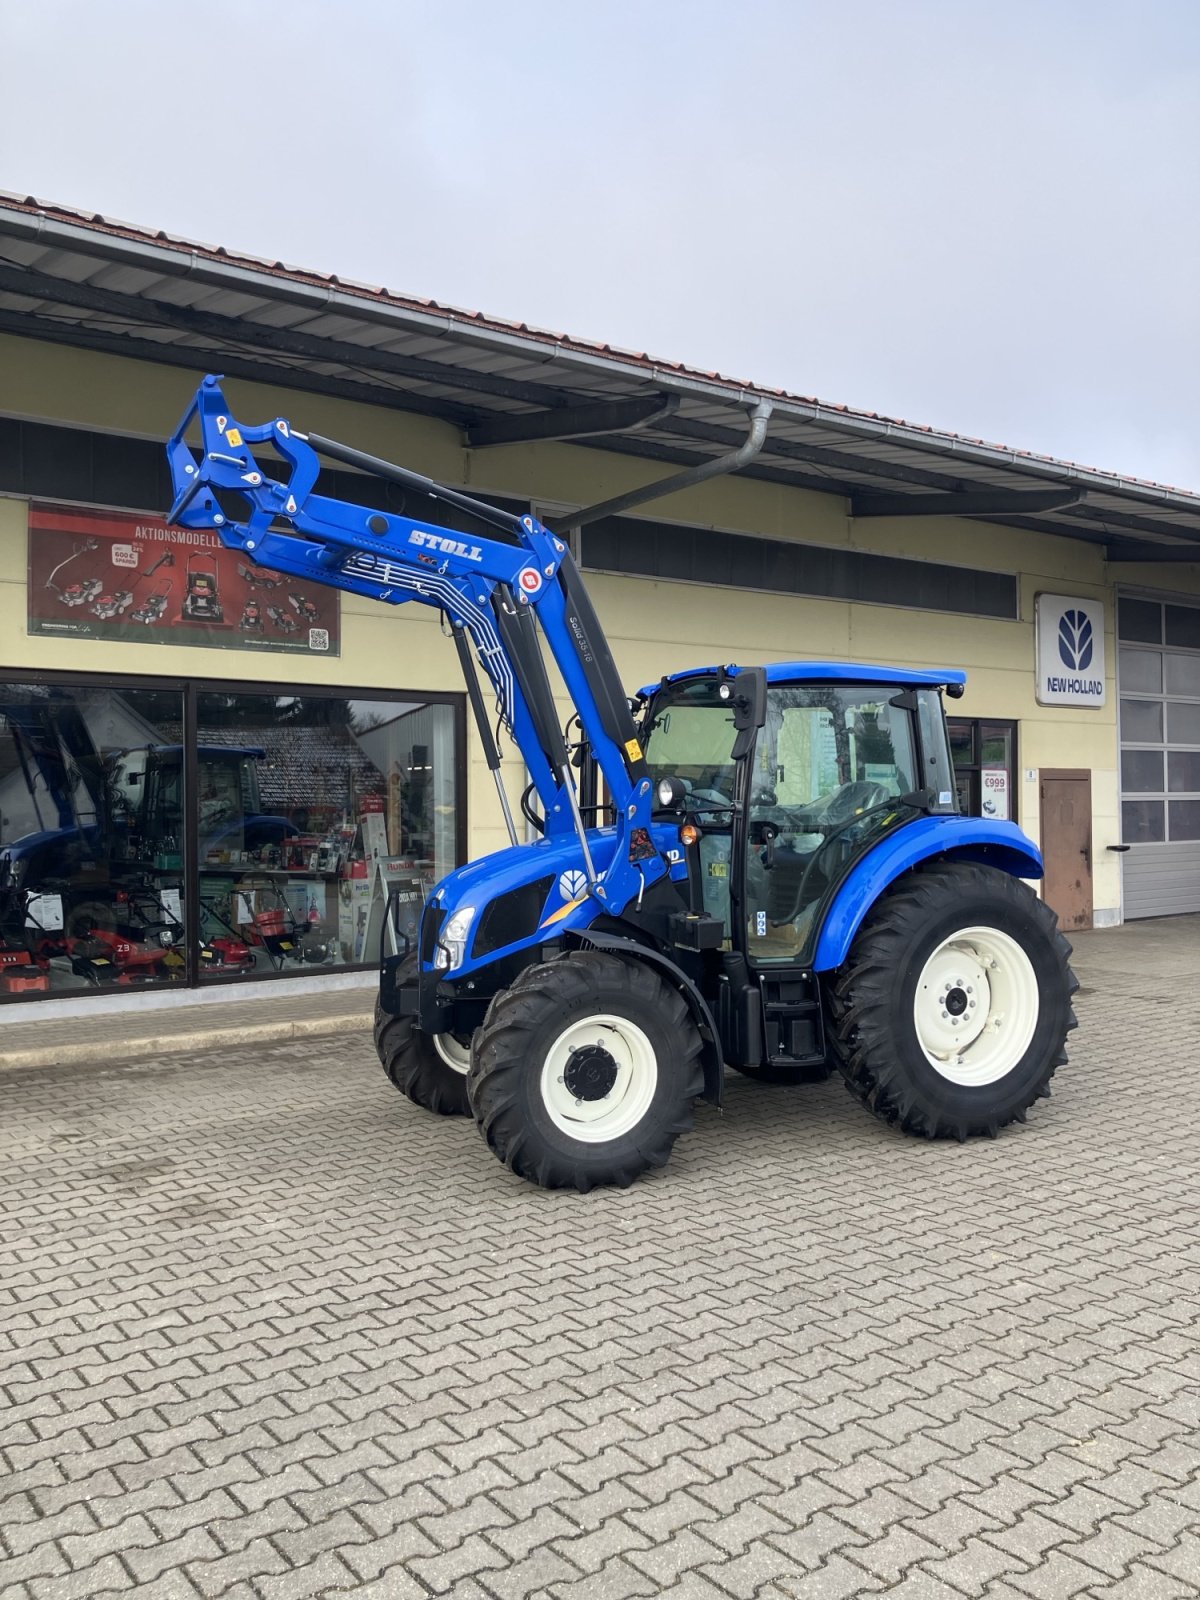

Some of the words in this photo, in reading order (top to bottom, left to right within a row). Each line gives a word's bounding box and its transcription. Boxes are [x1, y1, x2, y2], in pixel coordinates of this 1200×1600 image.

[135, 526, 223, 548] AKTIONSMODELLE
[408, 530, 482, 562] STOLL
[115, 557, 136, 565] SPAREN
[569, 616, 584, 639] Solid
[578, 639, 593, 662] 35-18
[1047, 677, 1067, 693] NEW
[1067, 679, 1103, 695] HOLLAND
[984, 777, 1005, 788] €999
[386, 862, 416, 872] HONDA
